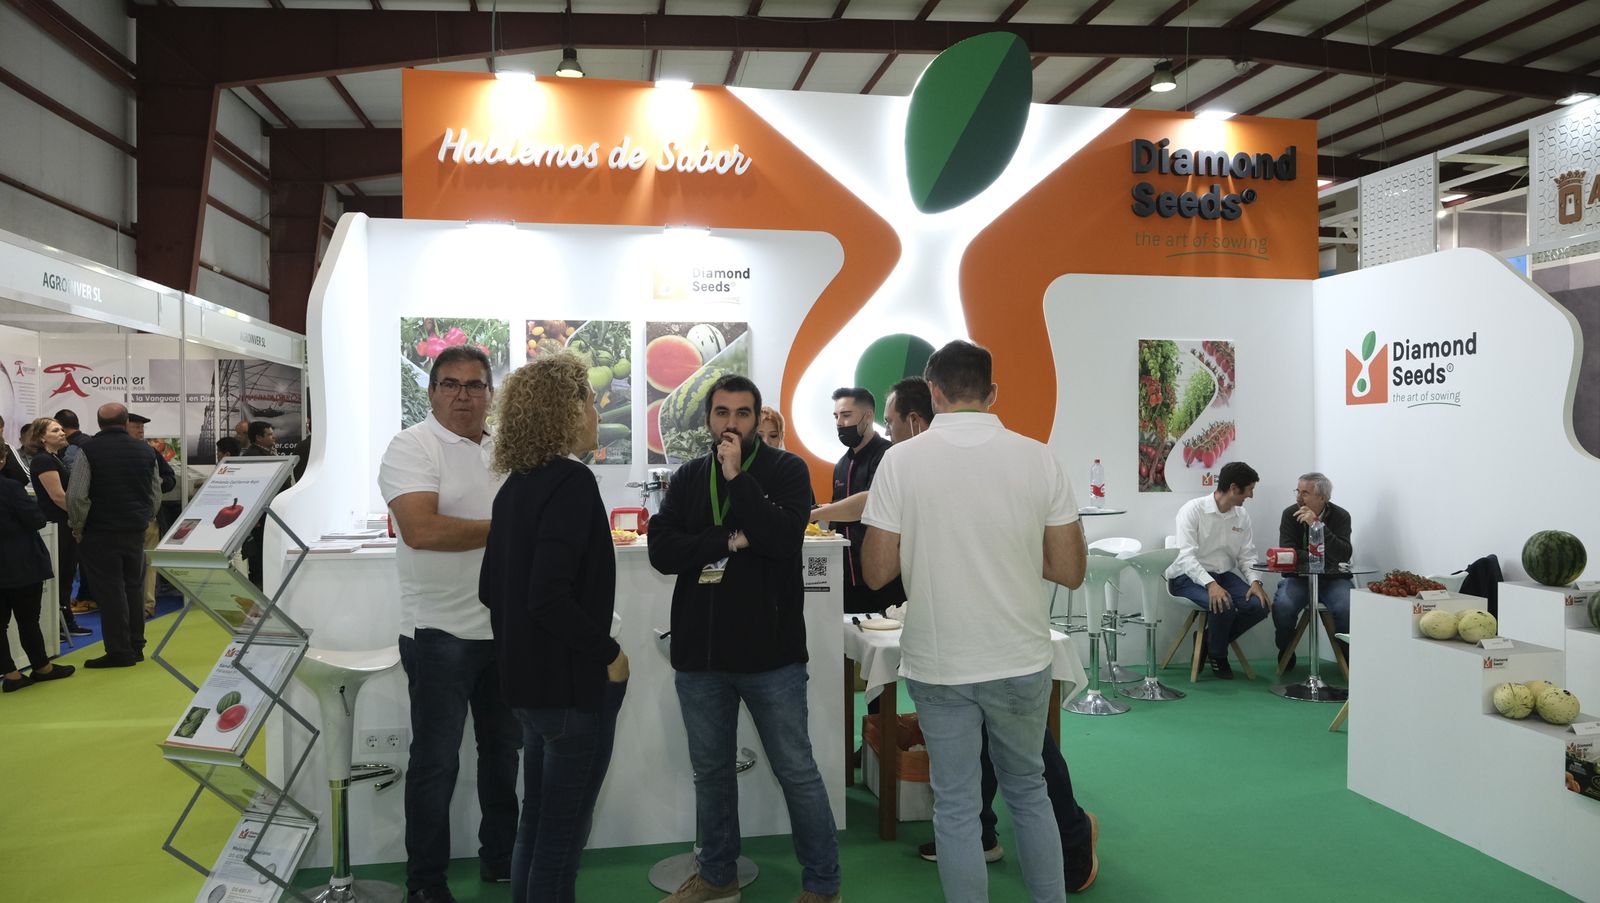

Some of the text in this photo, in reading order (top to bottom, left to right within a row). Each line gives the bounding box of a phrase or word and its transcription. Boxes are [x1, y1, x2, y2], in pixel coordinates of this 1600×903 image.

[437, 127, 752, 175] Hablemos de Sabor
[1131, 138, 1297, 181] Diamond
[1136, 231, 1269, 254] the art of sowing
[692, 267, 750, 279] Diamond
[1392, 331, 1477, 361] Diamond
[1392, 390, 1461, 403] the art of sowing
